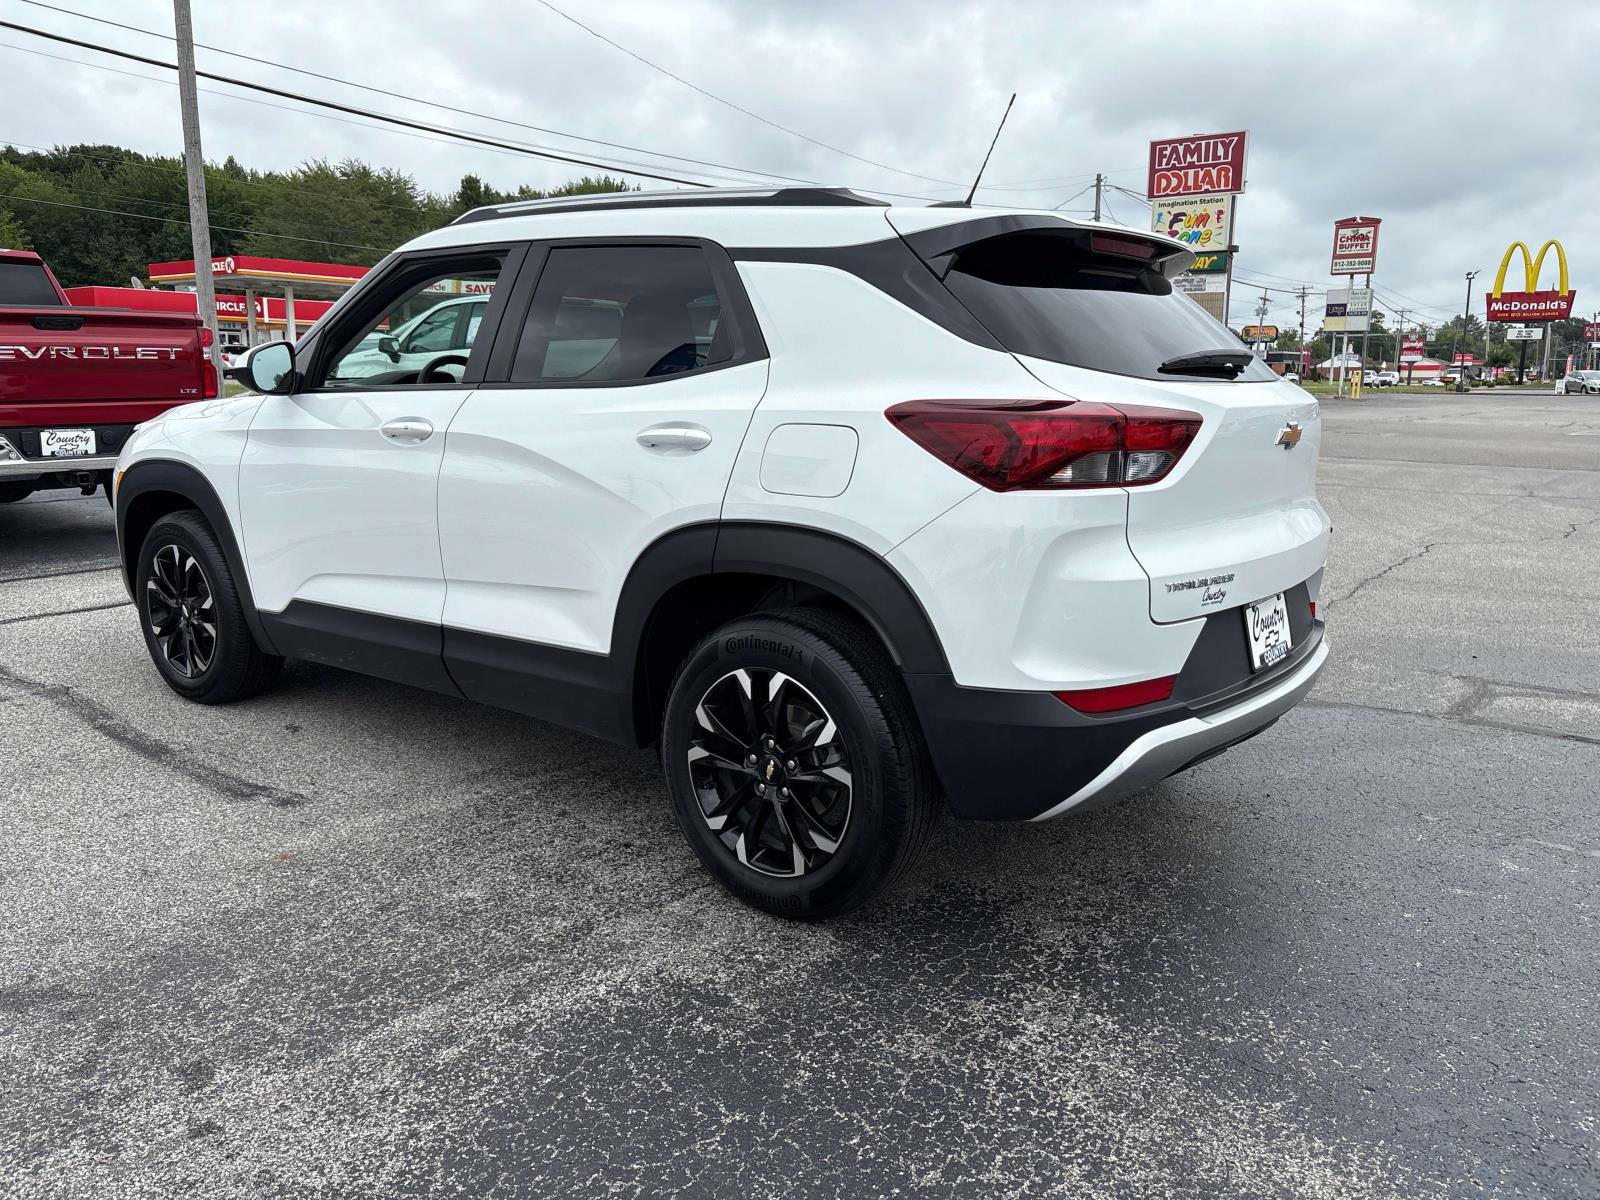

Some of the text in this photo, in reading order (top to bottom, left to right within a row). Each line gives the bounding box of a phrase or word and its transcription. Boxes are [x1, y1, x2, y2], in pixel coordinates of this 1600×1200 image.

[1155, 137, 1236, 168] FAMILY
[1154, 165, 1232, 195] DOLLAR
[1158, 200, 1198, 208] Imagination
[1168, 211, 1210, 230] Fun
[1339, 233, 1371, 243] CHINA
[1490, 300, 1567, 311] McDonald's
[46, 432, 91, 446] Country
[1165, 573, 1235, 593] TRAILBLAZER
[1253, 605, 1285, 642] Country
[726, 635, 794, 659] Continental
[1264, 643, 1287, 664] COUNTRY
